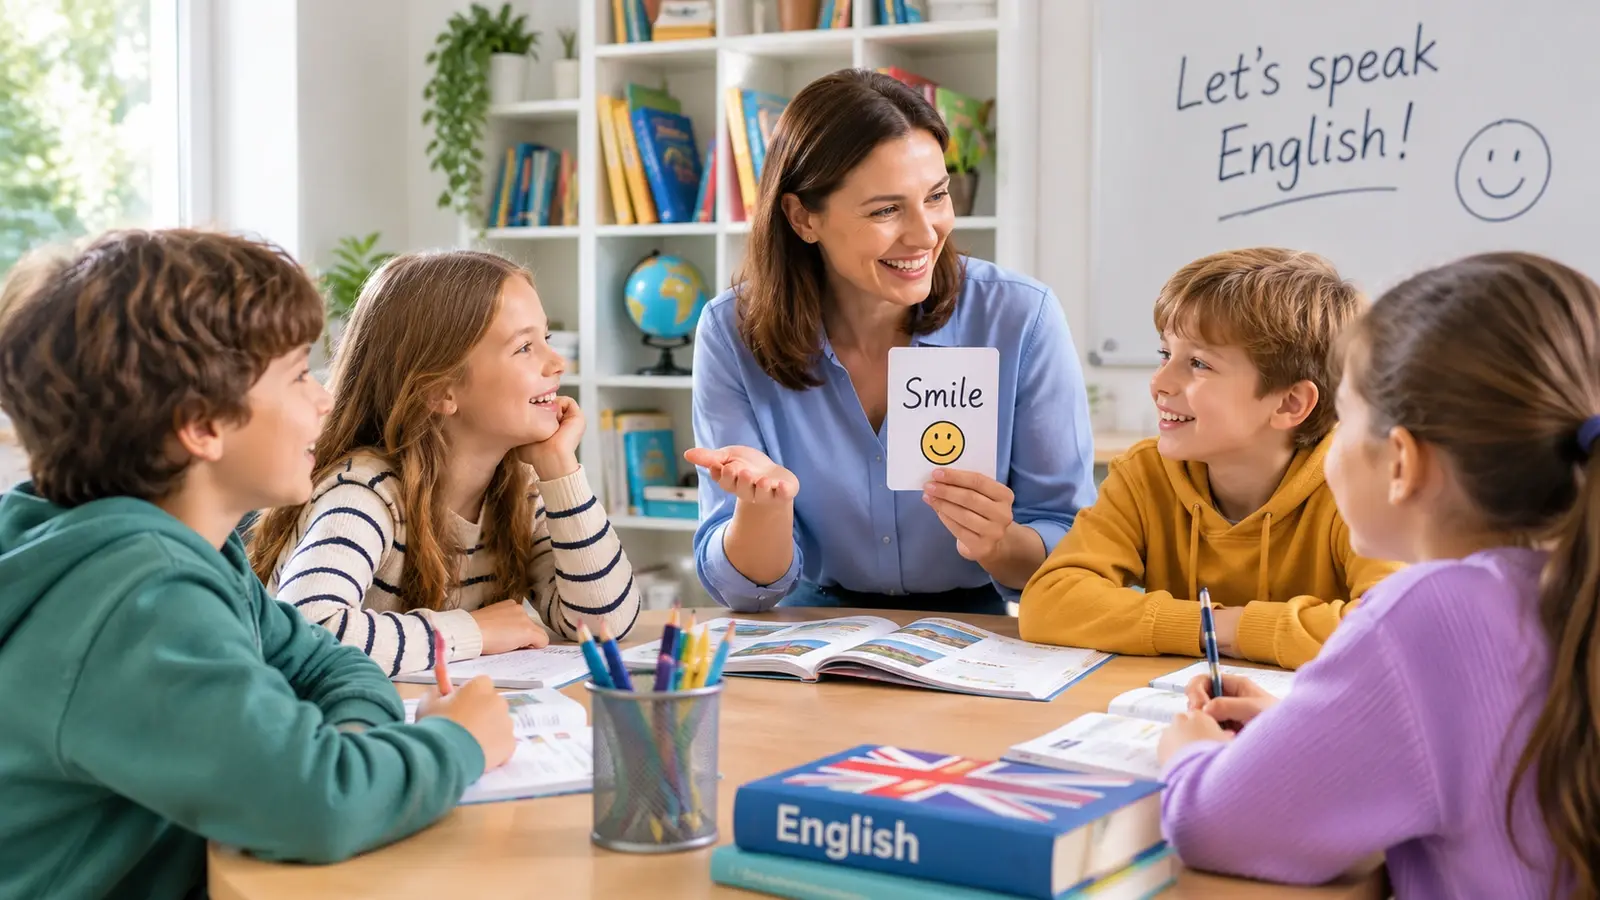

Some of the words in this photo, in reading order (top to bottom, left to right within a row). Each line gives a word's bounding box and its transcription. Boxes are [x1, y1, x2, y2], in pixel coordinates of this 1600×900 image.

[1176, 46, 1281, 111] Let's
[1307, 22, 1439, 108] speak
[1218, 101, 1414, 192] English!
[903, 376, 984, 409] Smile
[776, 803, 920, 864] English
